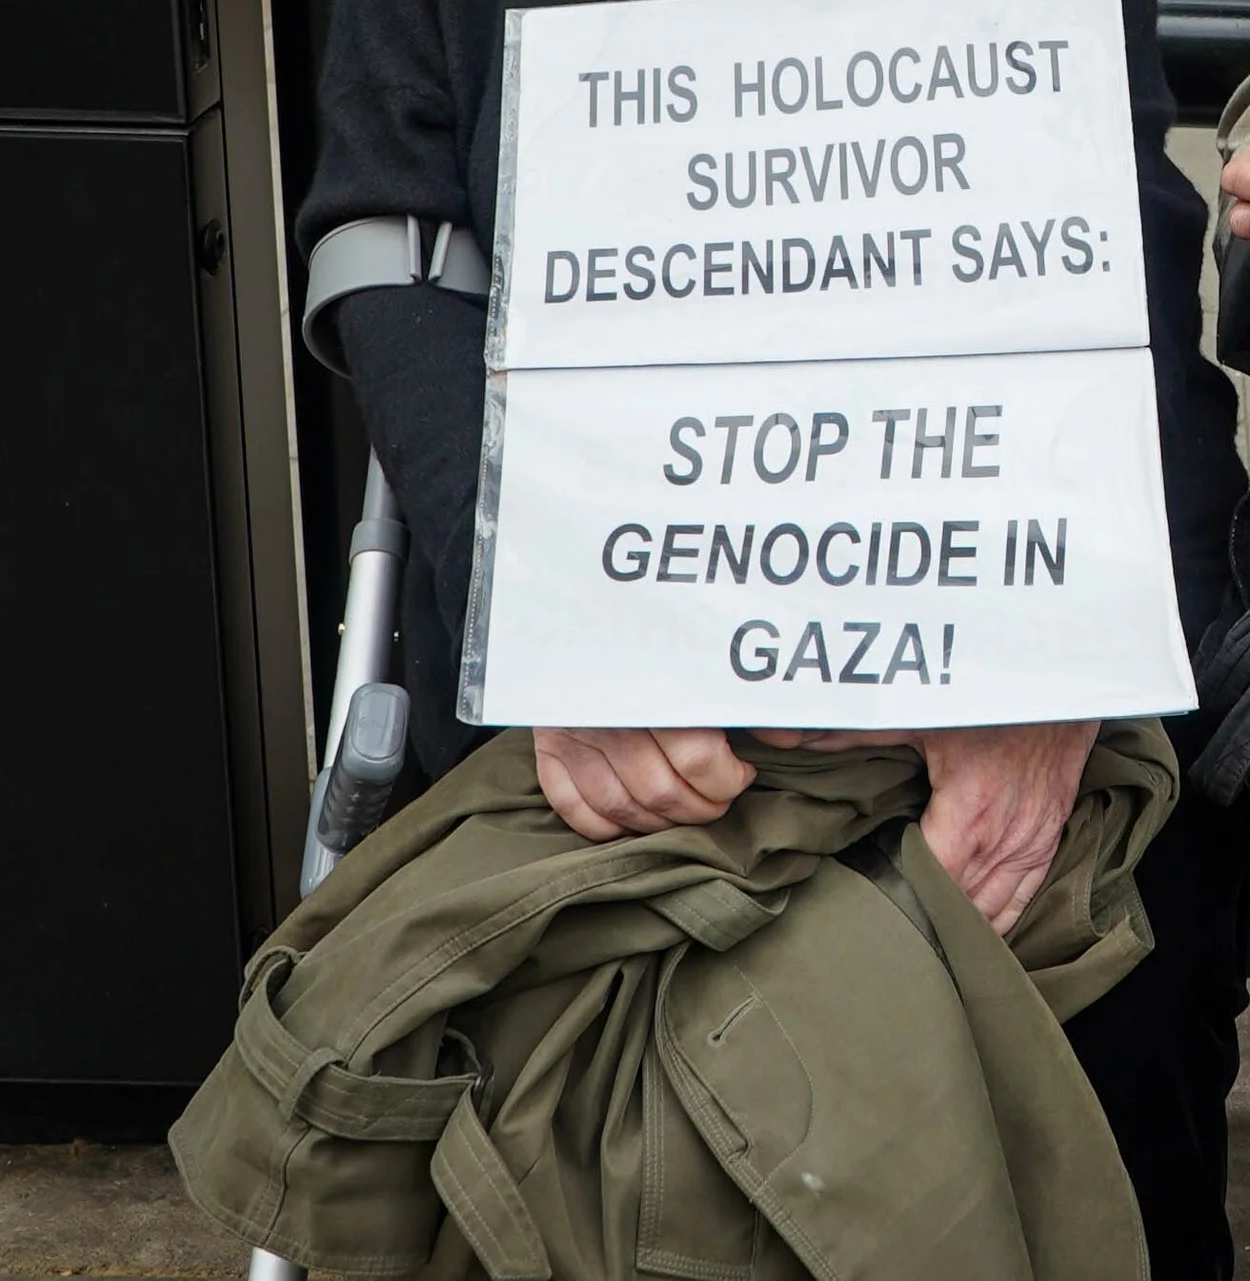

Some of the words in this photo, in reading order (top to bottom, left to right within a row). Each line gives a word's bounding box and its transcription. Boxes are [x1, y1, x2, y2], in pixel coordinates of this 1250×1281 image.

[578, 65, 698, 128] THIS
[734, 40, 1070, 118] HOLOCAUST
[686, 132, 971, 211] SURVIVOR
[543, 228, 932, 305] DESCENDANT
[951, 216, 1112, 284] SAYS:
[662, 411, 850, 487] STOP
[871, 404, 1003, 480] THE
[601, 520, 980, 587] GENOCIDE
[1003, 517, 1068, 587] IN
[729, 619, 956, 685] GAZA!
